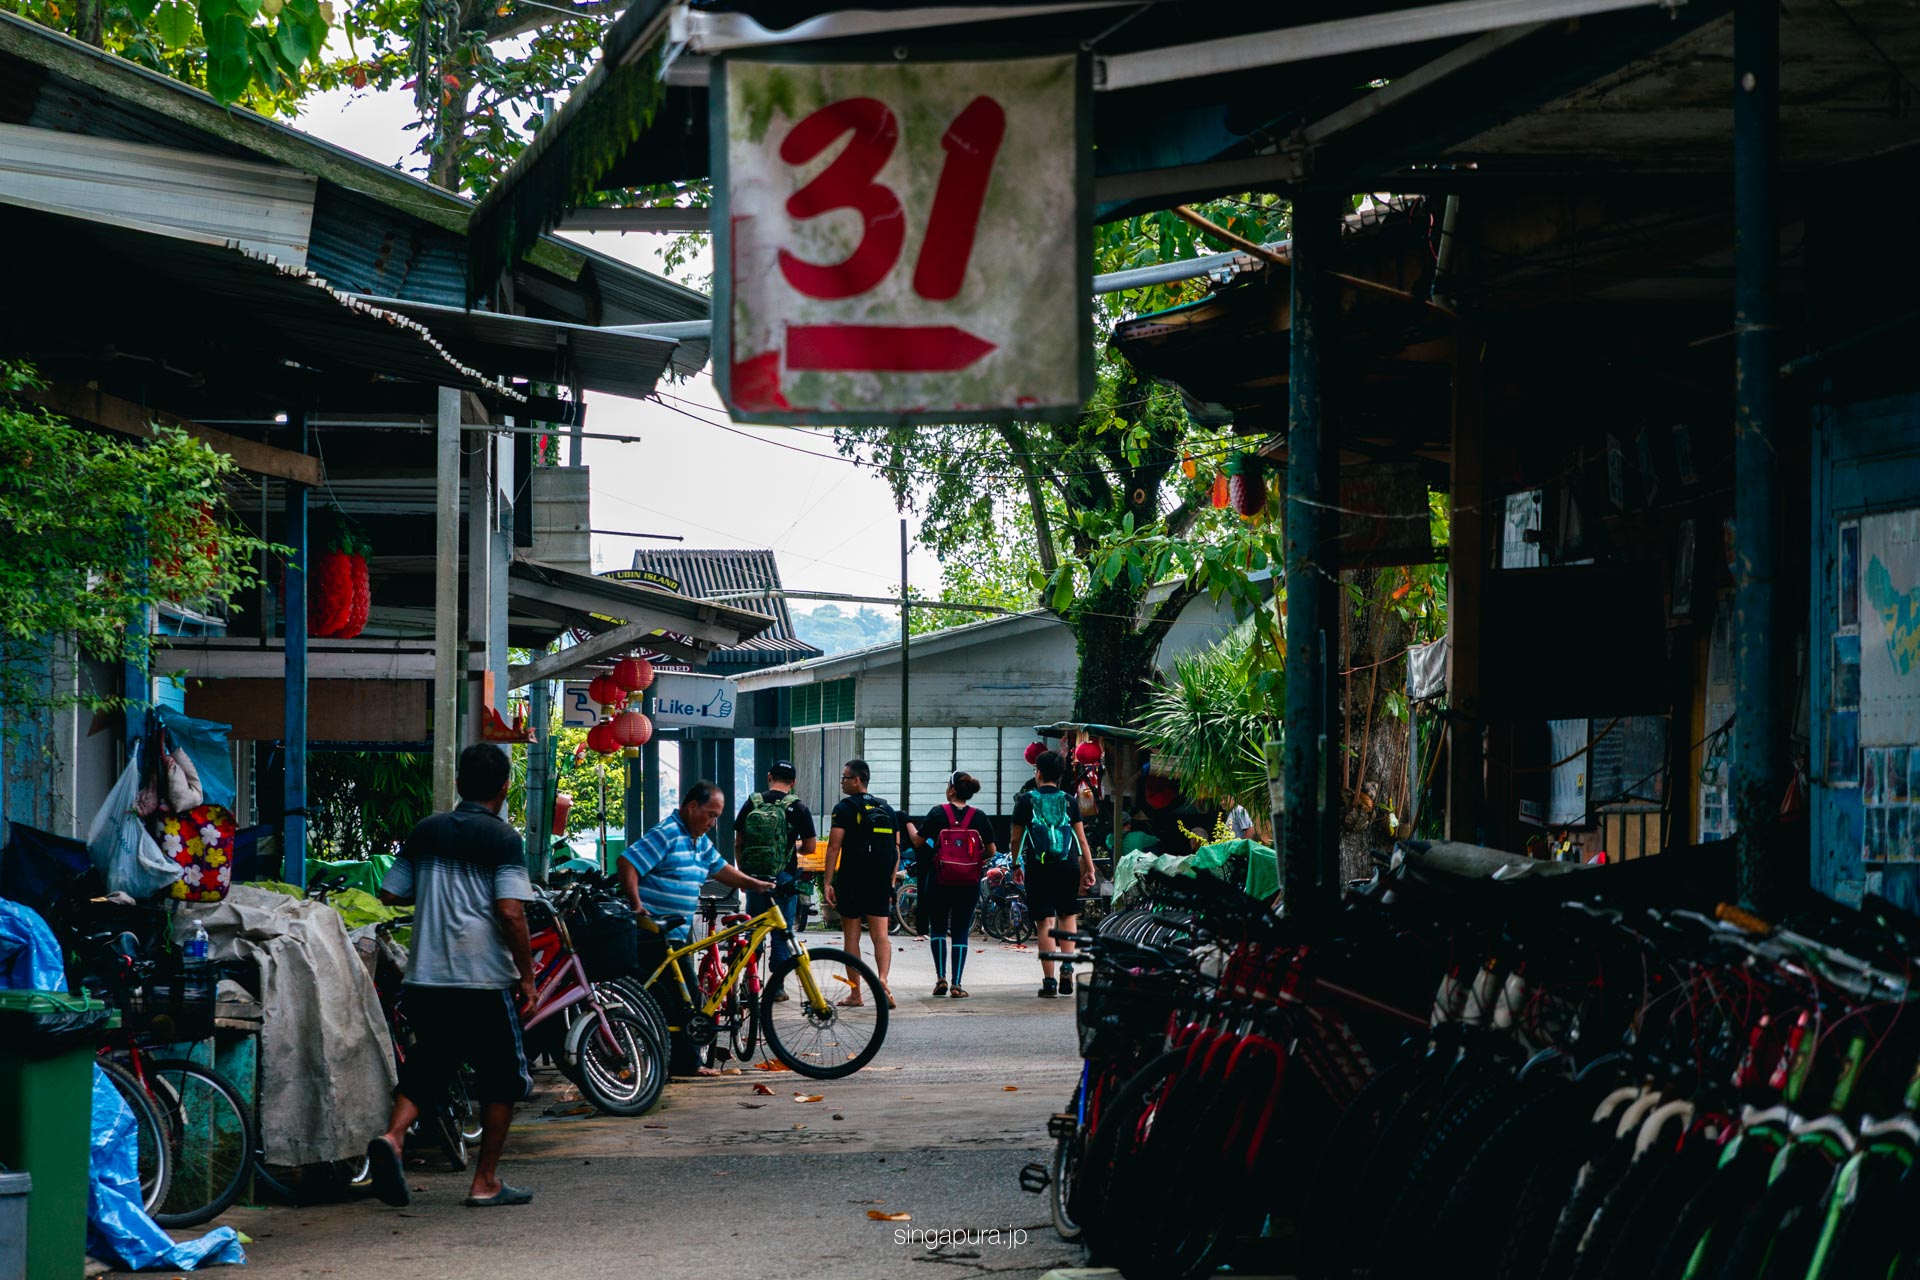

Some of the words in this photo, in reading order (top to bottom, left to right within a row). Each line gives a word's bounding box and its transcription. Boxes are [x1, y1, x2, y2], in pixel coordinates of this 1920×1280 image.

[778, 95, 1006, 301] 31
[617, 571, 641, 579] UBIN
[644, 572, 678, 590] ISLAND
